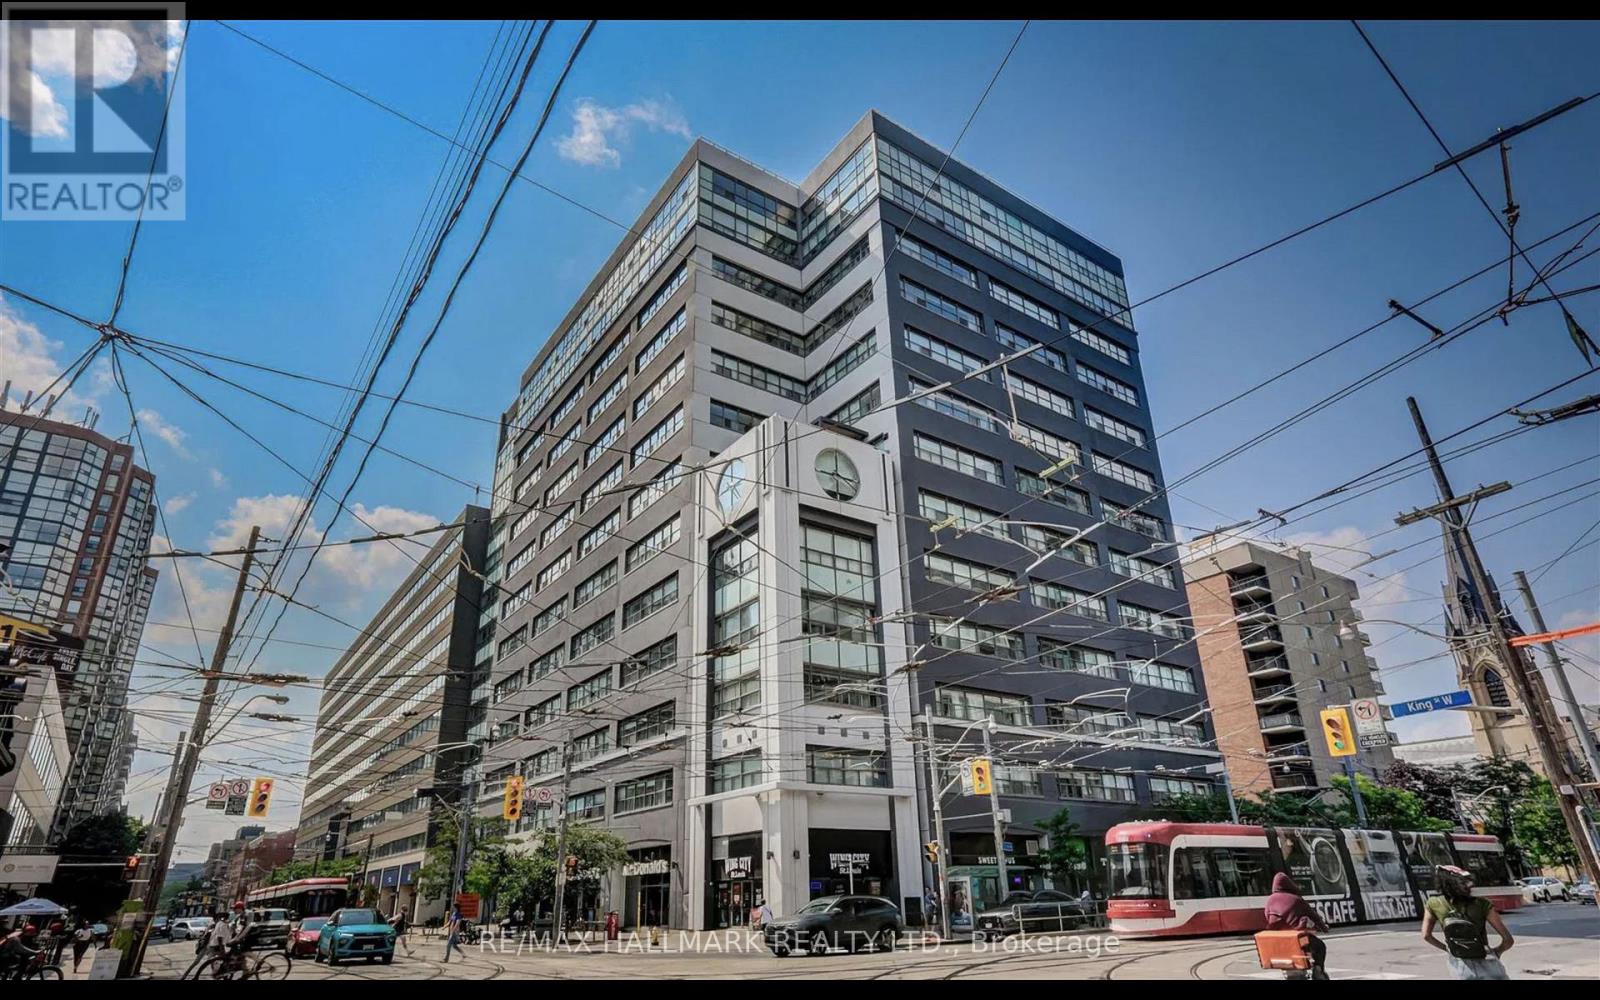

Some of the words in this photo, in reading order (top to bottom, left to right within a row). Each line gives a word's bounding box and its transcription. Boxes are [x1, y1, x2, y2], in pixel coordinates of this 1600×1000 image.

[1407, 701, 1434, 712] King
[1441, 695, 1453, 705] W
[739, 856, 752, 873] CITY
[978, 856, 997, 865] SWEET
